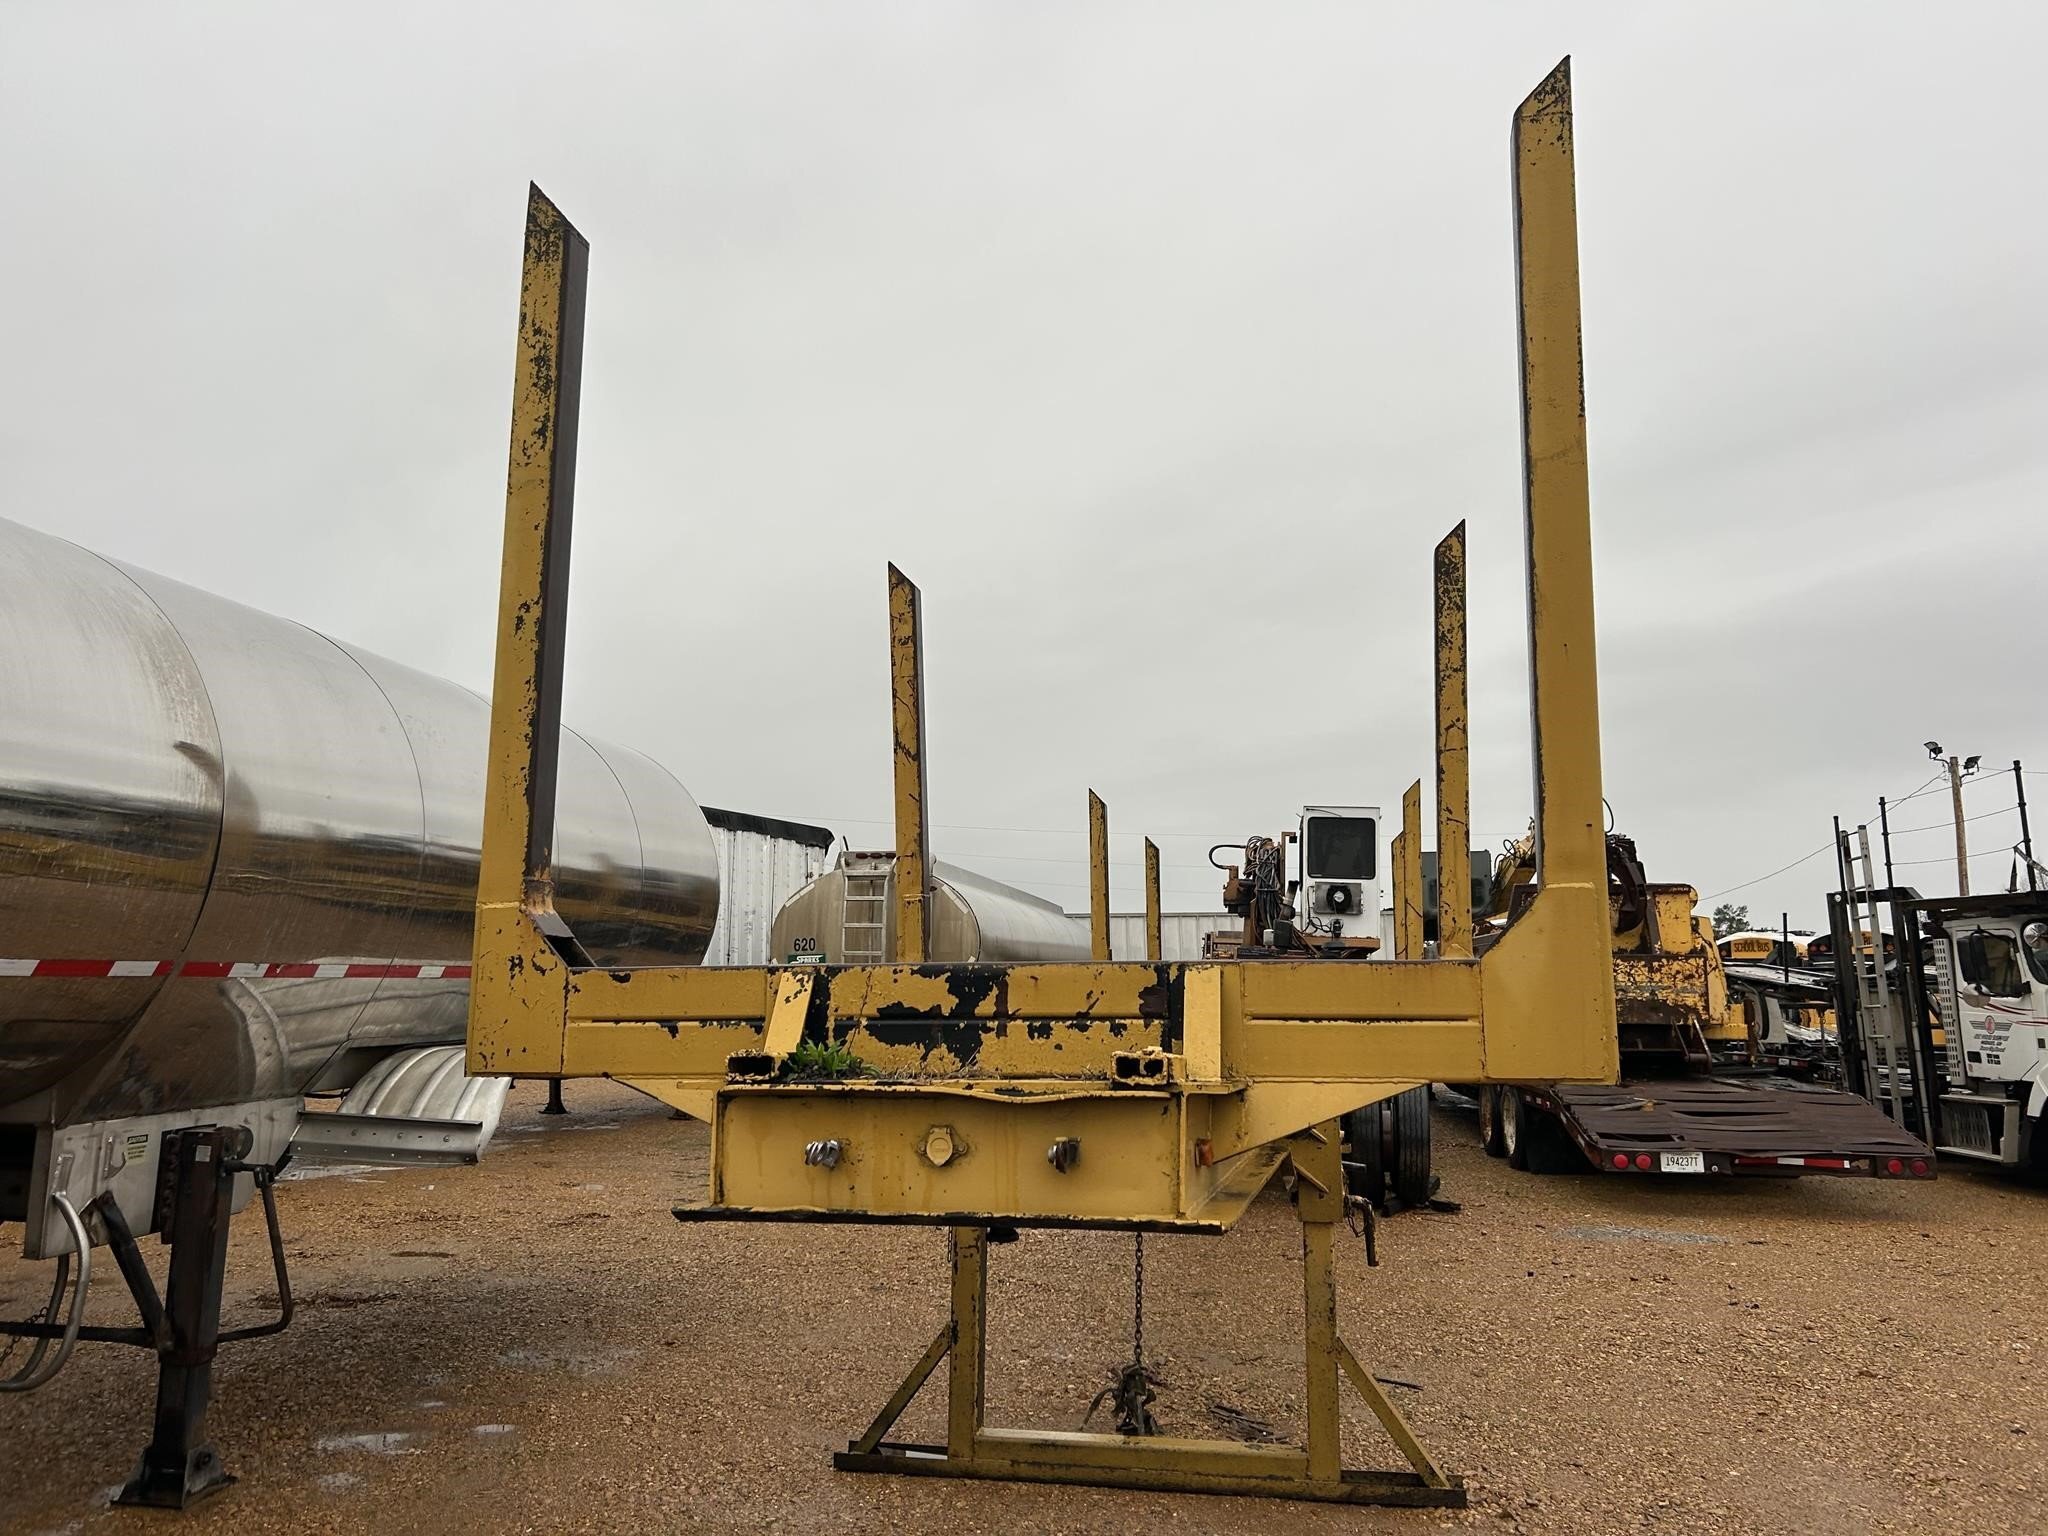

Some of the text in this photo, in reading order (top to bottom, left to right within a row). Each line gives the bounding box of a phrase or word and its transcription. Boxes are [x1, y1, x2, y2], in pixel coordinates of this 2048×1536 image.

[794, 937, 816, 952] 620
[1734, 940, 1770, 953] SCHOOL BUS
[1666, 1156, 1698, 1167] 194237T
